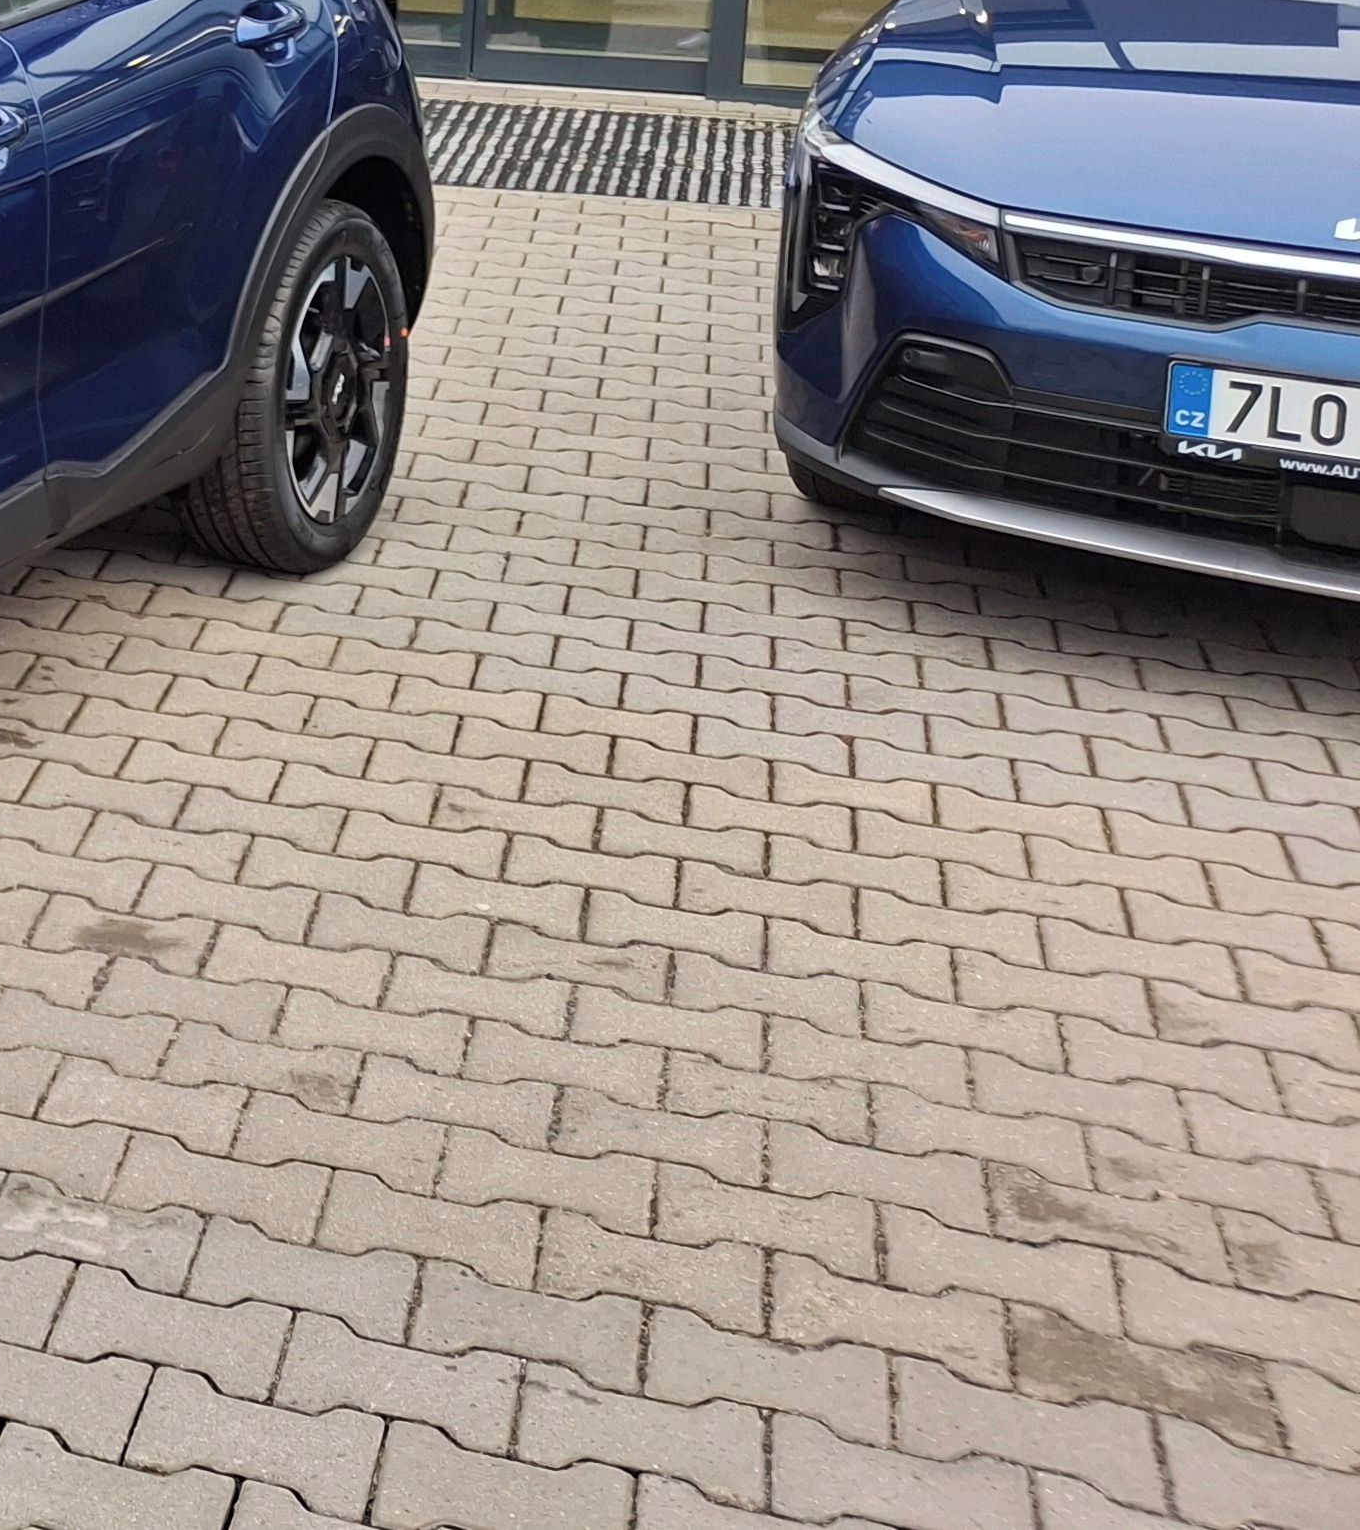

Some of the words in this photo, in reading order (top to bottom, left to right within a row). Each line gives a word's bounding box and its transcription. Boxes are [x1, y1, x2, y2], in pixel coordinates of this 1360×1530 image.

[1175, 409, 1206, 428] CZ
[1177, 440, 1242, 462] KIA
[1279, 458, 1360, 480] www.AU
